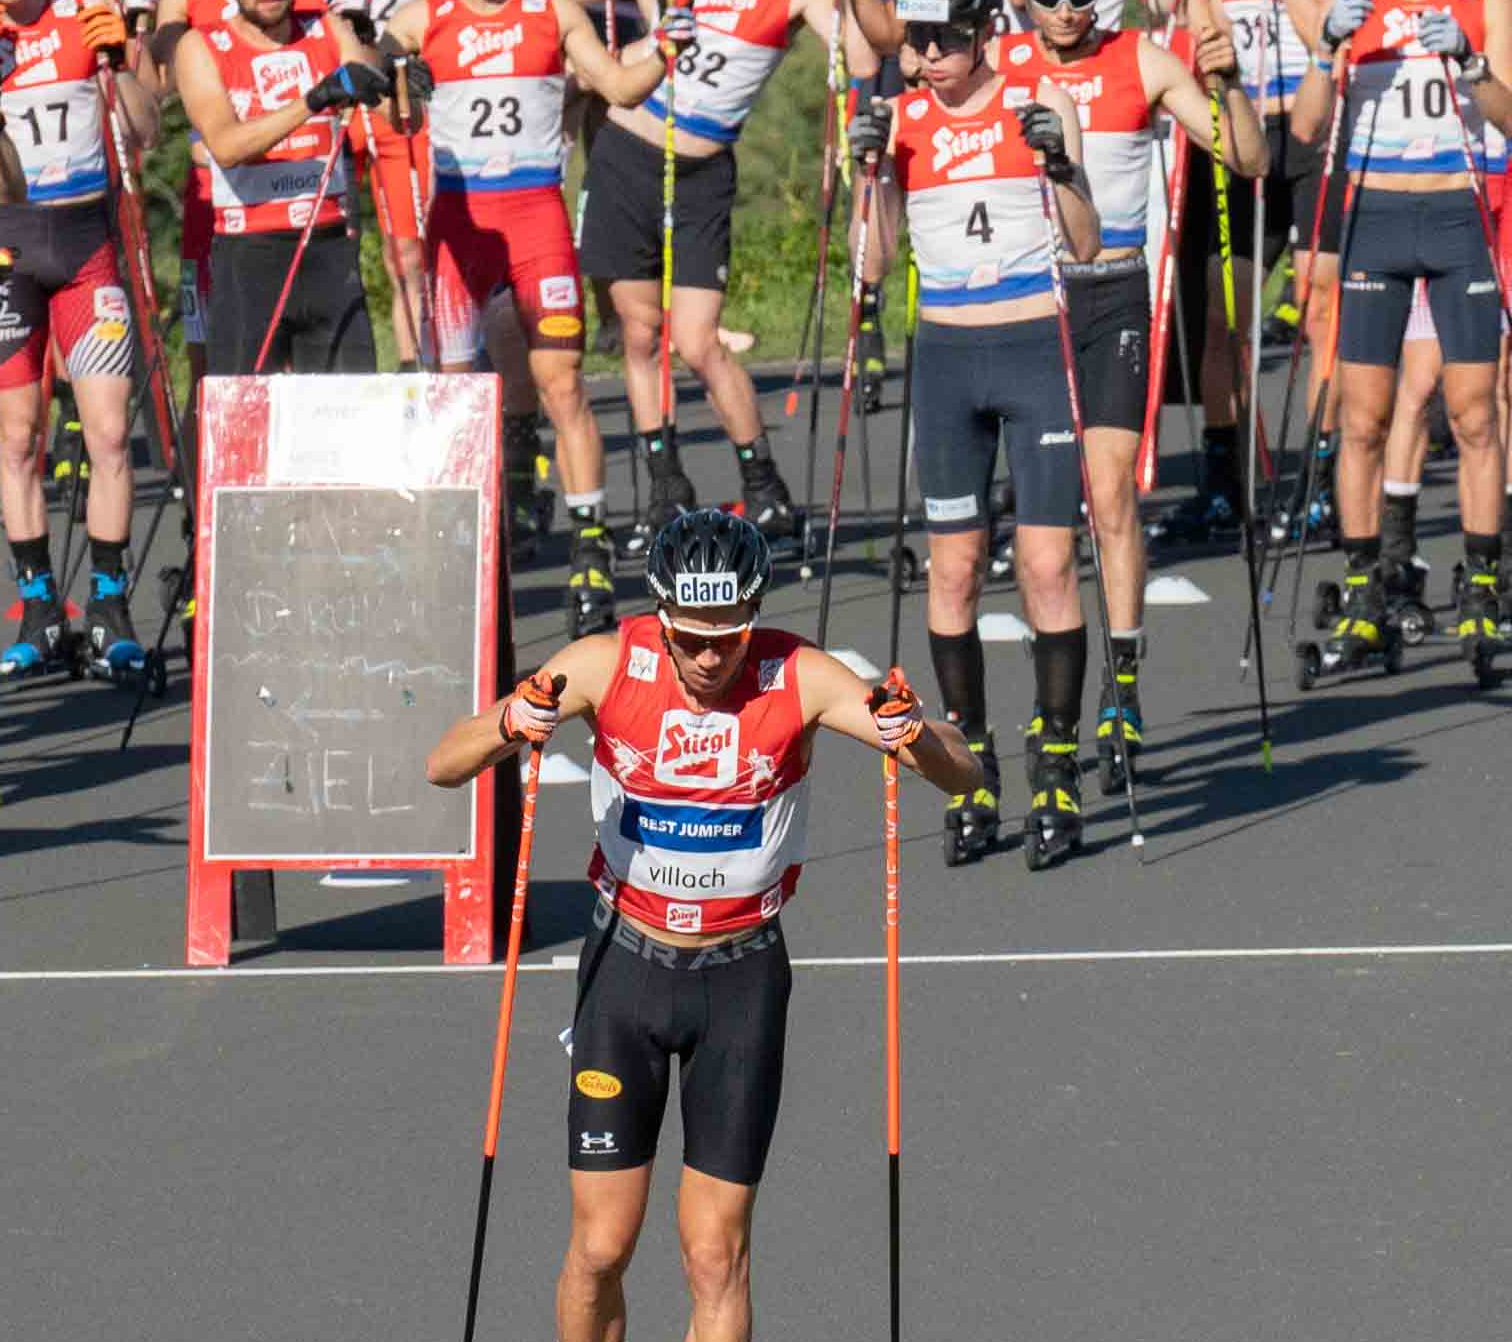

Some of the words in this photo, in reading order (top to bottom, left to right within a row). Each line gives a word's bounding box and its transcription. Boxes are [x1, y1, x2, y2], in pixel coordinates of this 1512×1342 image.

[458, 22, 524, 67] Stiegl
[470, 96, 522, 138] 23
[1396, 78, 1448, 119] 10
[19, 102, 69, 147] 17
[933, 121, 1004, 172] Stiegl
[966, 202, 995, 244] 4
[680, 577, 734, 603] claro
[660, 722, 732, 764] Stiegl
[638, 816, 676, 835] BEST
[678, 822, 743, 839] JUMPER
[648, 865, 726, 890] villach
